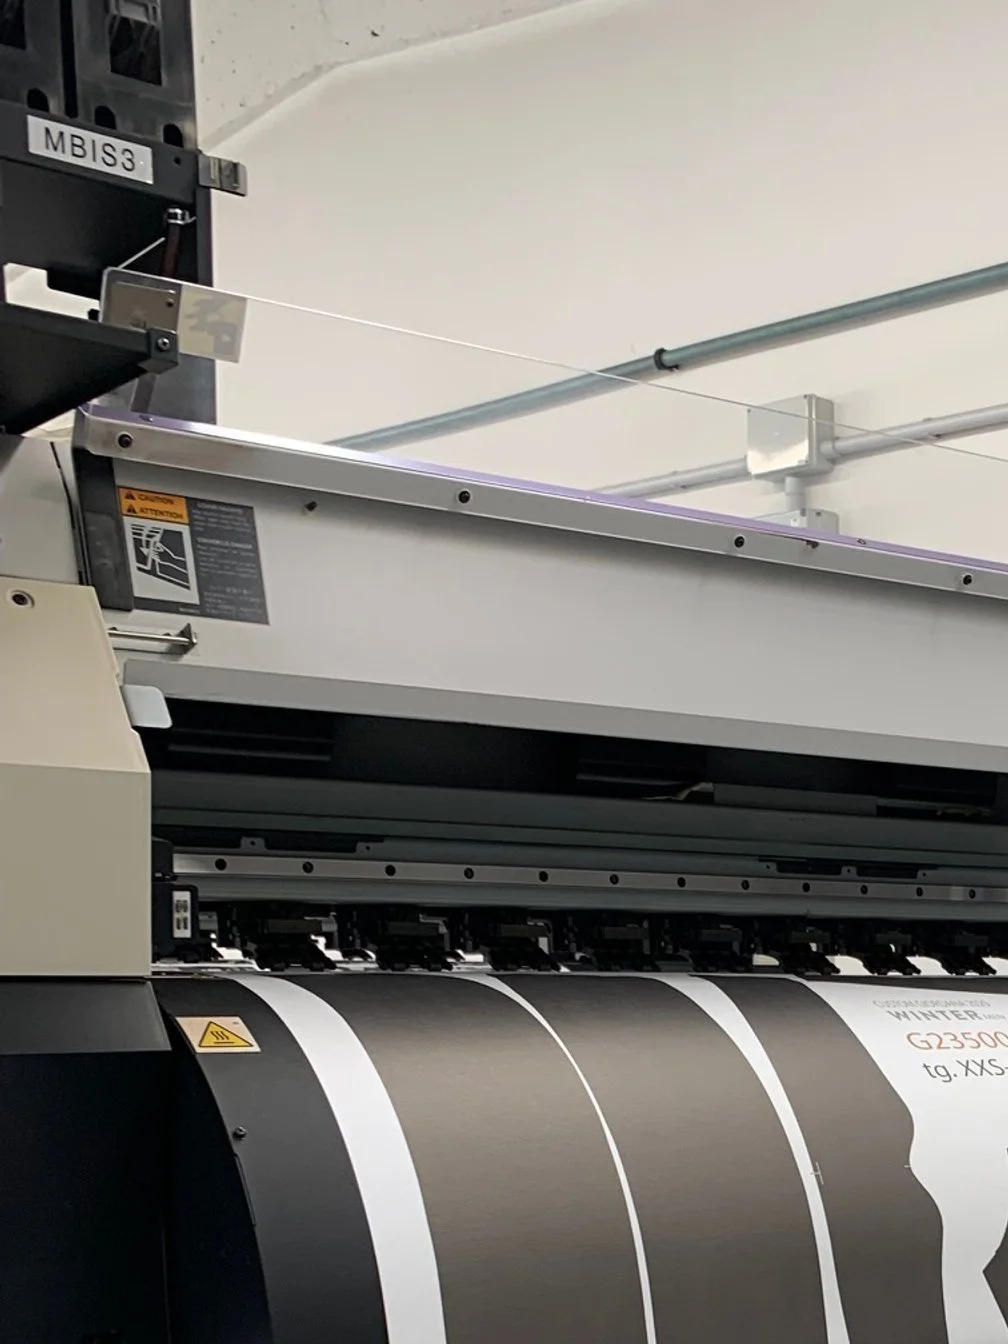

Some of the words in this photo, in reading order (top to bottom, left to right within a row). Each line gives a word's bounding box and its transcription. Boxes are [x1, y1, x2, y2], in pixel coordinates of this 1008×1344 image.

[45, 126, 135, 171] MBIS3
[138, 493, 175, 505] CAUTION
[139, 507, 183, 519] ATTENTION
[887, 1009, 983, 1021] WINTER
